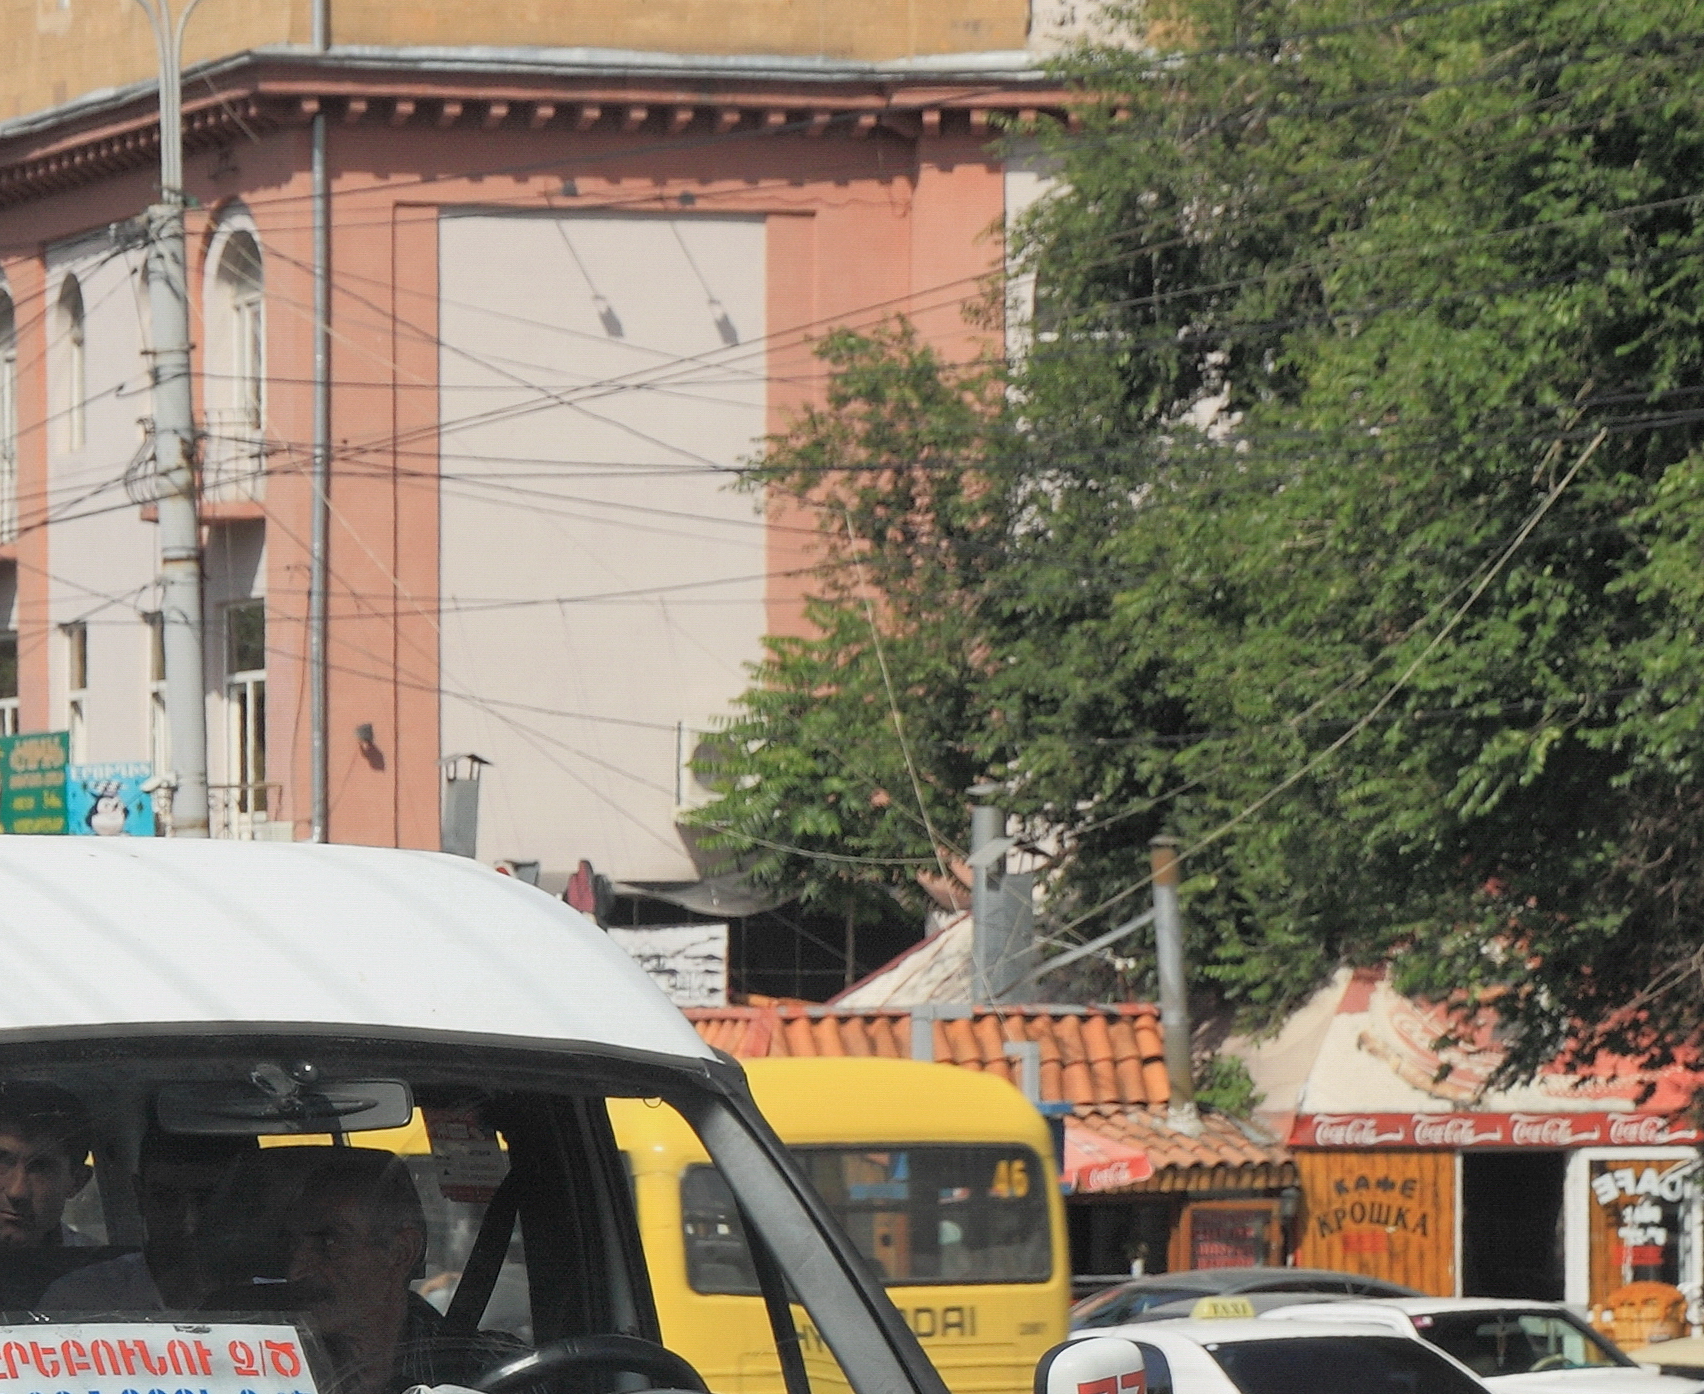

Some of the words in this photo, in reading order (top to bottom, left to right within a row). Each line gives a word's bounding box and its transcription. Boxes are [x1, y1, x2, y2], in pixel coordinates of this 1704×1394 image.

[1334, 1174, 1418, 1199] КАФЕ
[1316, 1200, 1429, 1239] КРОШКА
[897, 1306, 976, 1338] DAI
